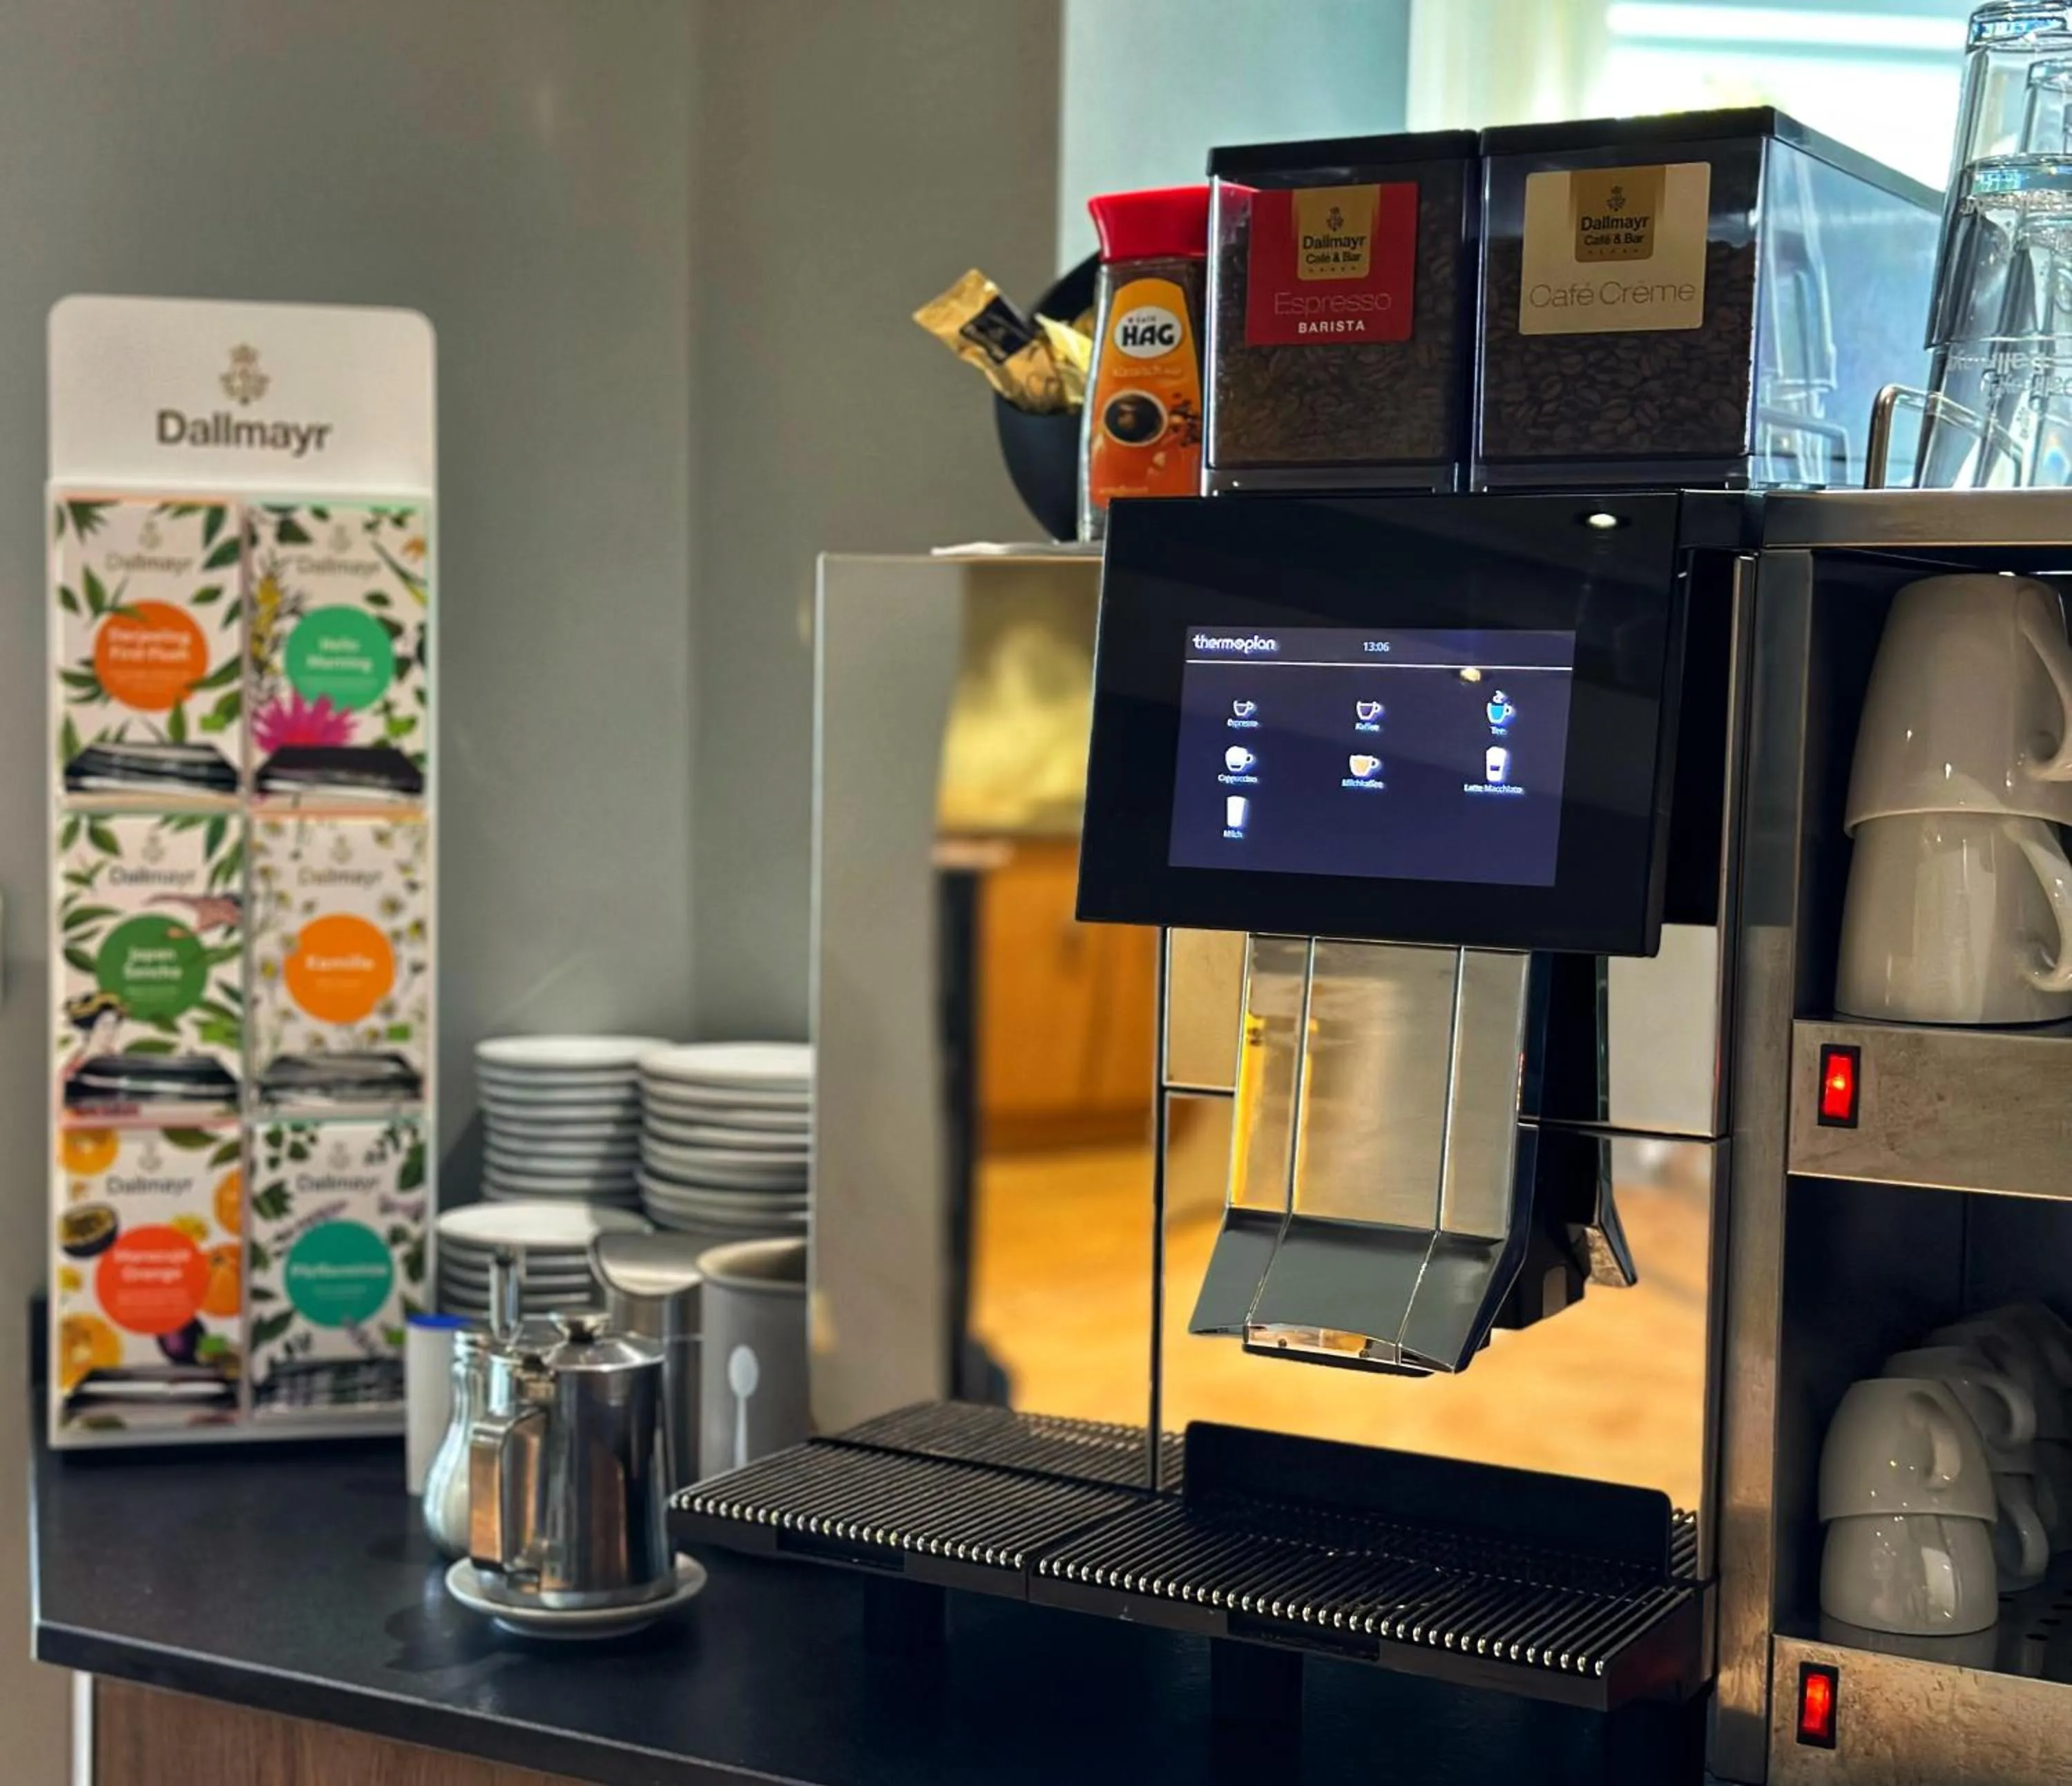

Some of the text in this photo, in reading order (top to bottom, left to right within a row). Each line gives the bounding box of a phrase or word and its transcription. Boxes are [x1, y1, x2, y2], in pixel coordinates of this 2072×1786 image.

[1580, 215, 1650, 231] Dallmayr
[1303, 235, 1367, 251] Dallmayr
[1624, 232, 1644, 244] Bar
[1343, 251, 1362, 262] Bar
[1274, 291, 1392, 318] Espresso
[1529, 279, 1696, 308] Café Crème
[1122, 323, 1175, 347] HAG
[1298, 320, 1365, 334] BARISTA
[157, 409, 330, 457] Dallmayr
[104, 553, 193, 575] Dallmayr
[296, 554, 381, 576] Dallmayr
[1192, 634, 1276, 654] thermoplan
[1363, 642, 1390, 652] 13:06
[108, 866, 196, 888] Dallmayr
[298, 865, 383, 888] Dallmayr
[106, 1175, 194, 1197] Dallmayr
[296, 1173, 381, 1195] Dallmayr
